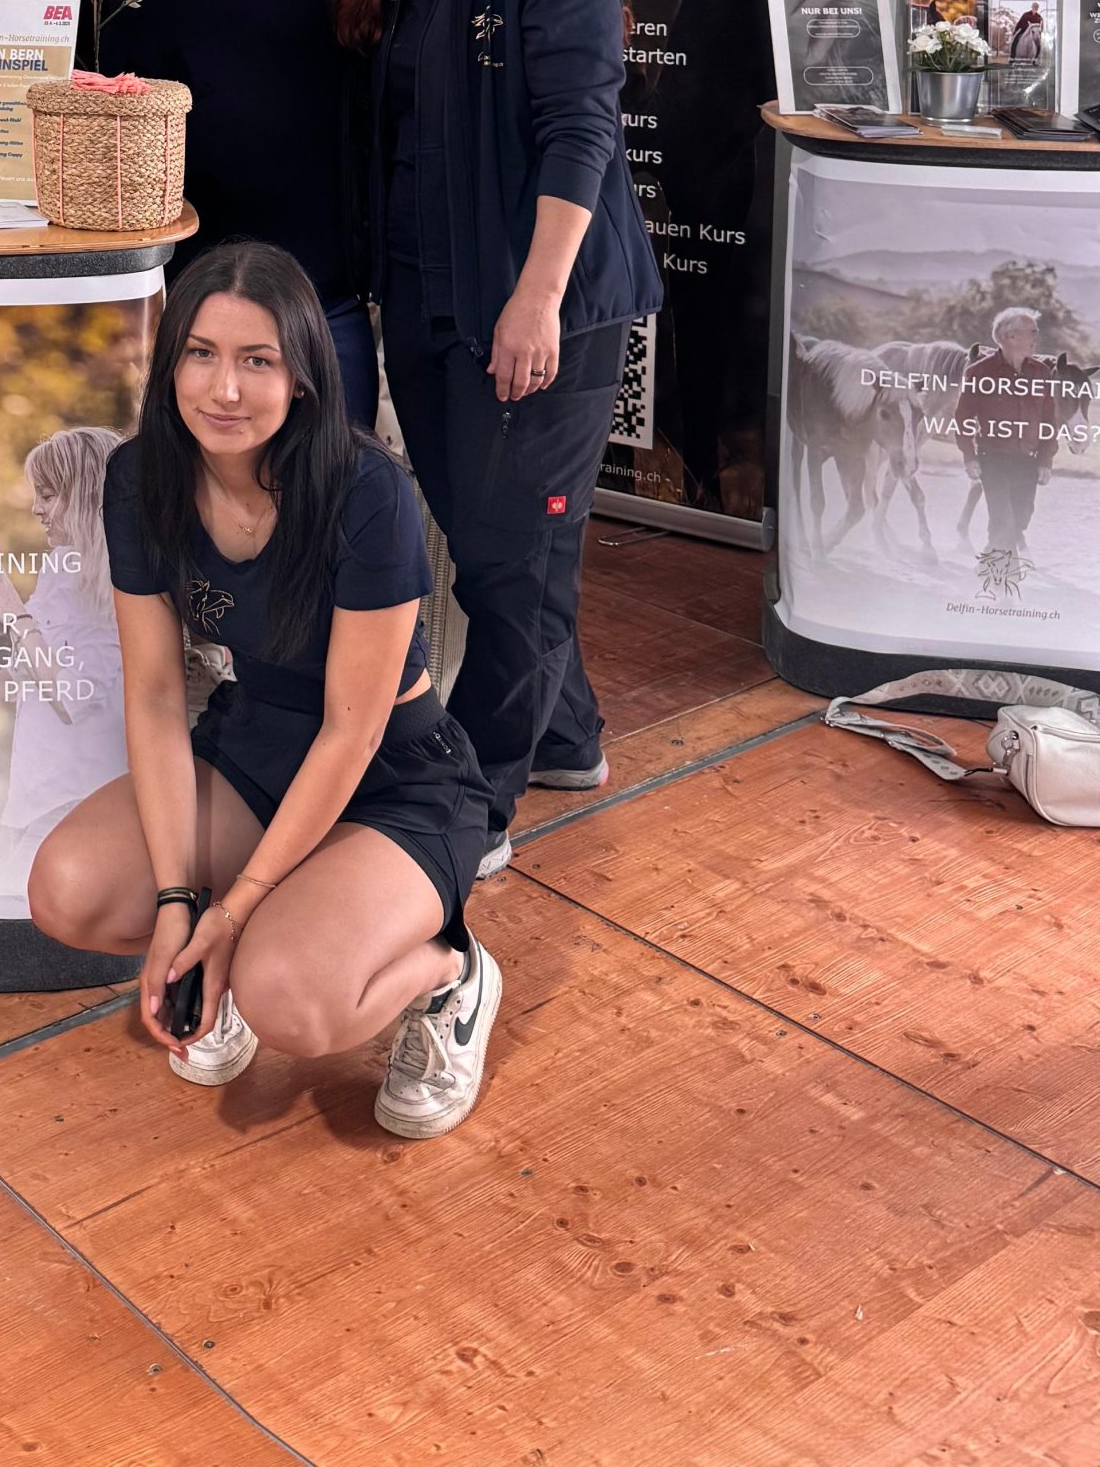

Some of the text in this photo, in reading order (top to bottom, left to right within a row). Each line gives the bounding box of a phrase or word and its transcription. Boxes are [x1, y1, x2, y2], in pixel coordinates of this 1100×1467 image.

[43, 6, 73, 20] BEA
[801, 7, 862, 15] NUR BEI UNS!
[10, 49, 44, 61] BERN
[699, 224, 747, 245] Kurs
[663, 252, 708, 274] Kurs
[923, 416, 1100, 443] WAS IST DAS?
[946, 602, 1061, 621] Delfin-Horsetraining.ch
[3, 678, 95, 703] PFERD
